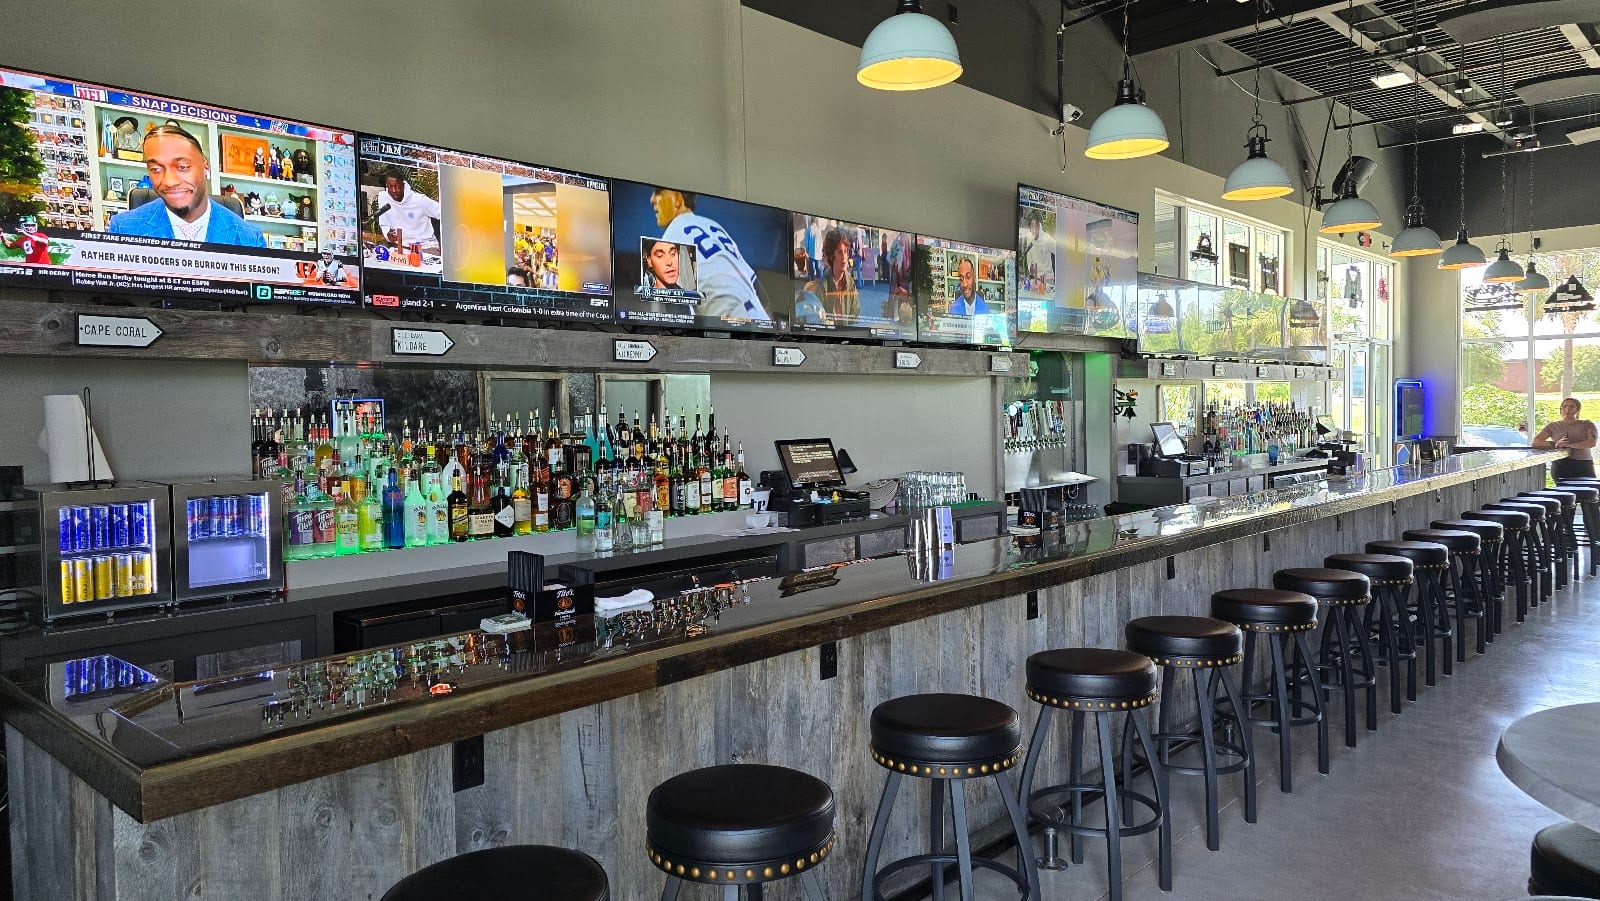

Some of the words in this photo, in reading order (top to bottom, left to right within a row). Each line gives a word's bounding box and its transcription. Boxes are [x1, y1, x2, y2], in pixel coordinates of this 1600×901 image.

[132, 96, 168, 111] SNAP
[170, 104, 238, 124] DECISIONS
[80, 232, 101, 240] FIRST
[102, 234, 120, 242] TAKE
[120, 235, 160, 245] PRESENTED
[81, 250, 116, 262] RATHER
[117, 254, 141, 264] HAVE
[142, 255, 180, 268] RODGERS
[181, 259, 194, 268] OR
[194, 260, 229, 271] BURROW
[230, 263, 248, 273] THIS
[75, 271, 97, 279] Home
[97, 272, 111, 280] Run
[112, 273, 133, 282] Derby
[133, 275, 158, 284] tonight
[191, 279, 210, 287] ESPN
[75, 278, 96, 287] Bobby
[173, 286, 192, 294] among
[422, 299, 434, 307] 2-1
[590, 298, 609, 307] ESPN
[455, 302, 487, 313] Argentina
[488, 304, 502, 312] beat
[503, 305, 532, 315] Colombia
[533, 307, 543, 315] 1-0
[543, 307, 550, 315] in
[578, 310, 586, 318] of
[595, 312, 610, 320] Copa
[84, 324, 111, 336] CAPE
[115, 326, 148, 338] CORAL
